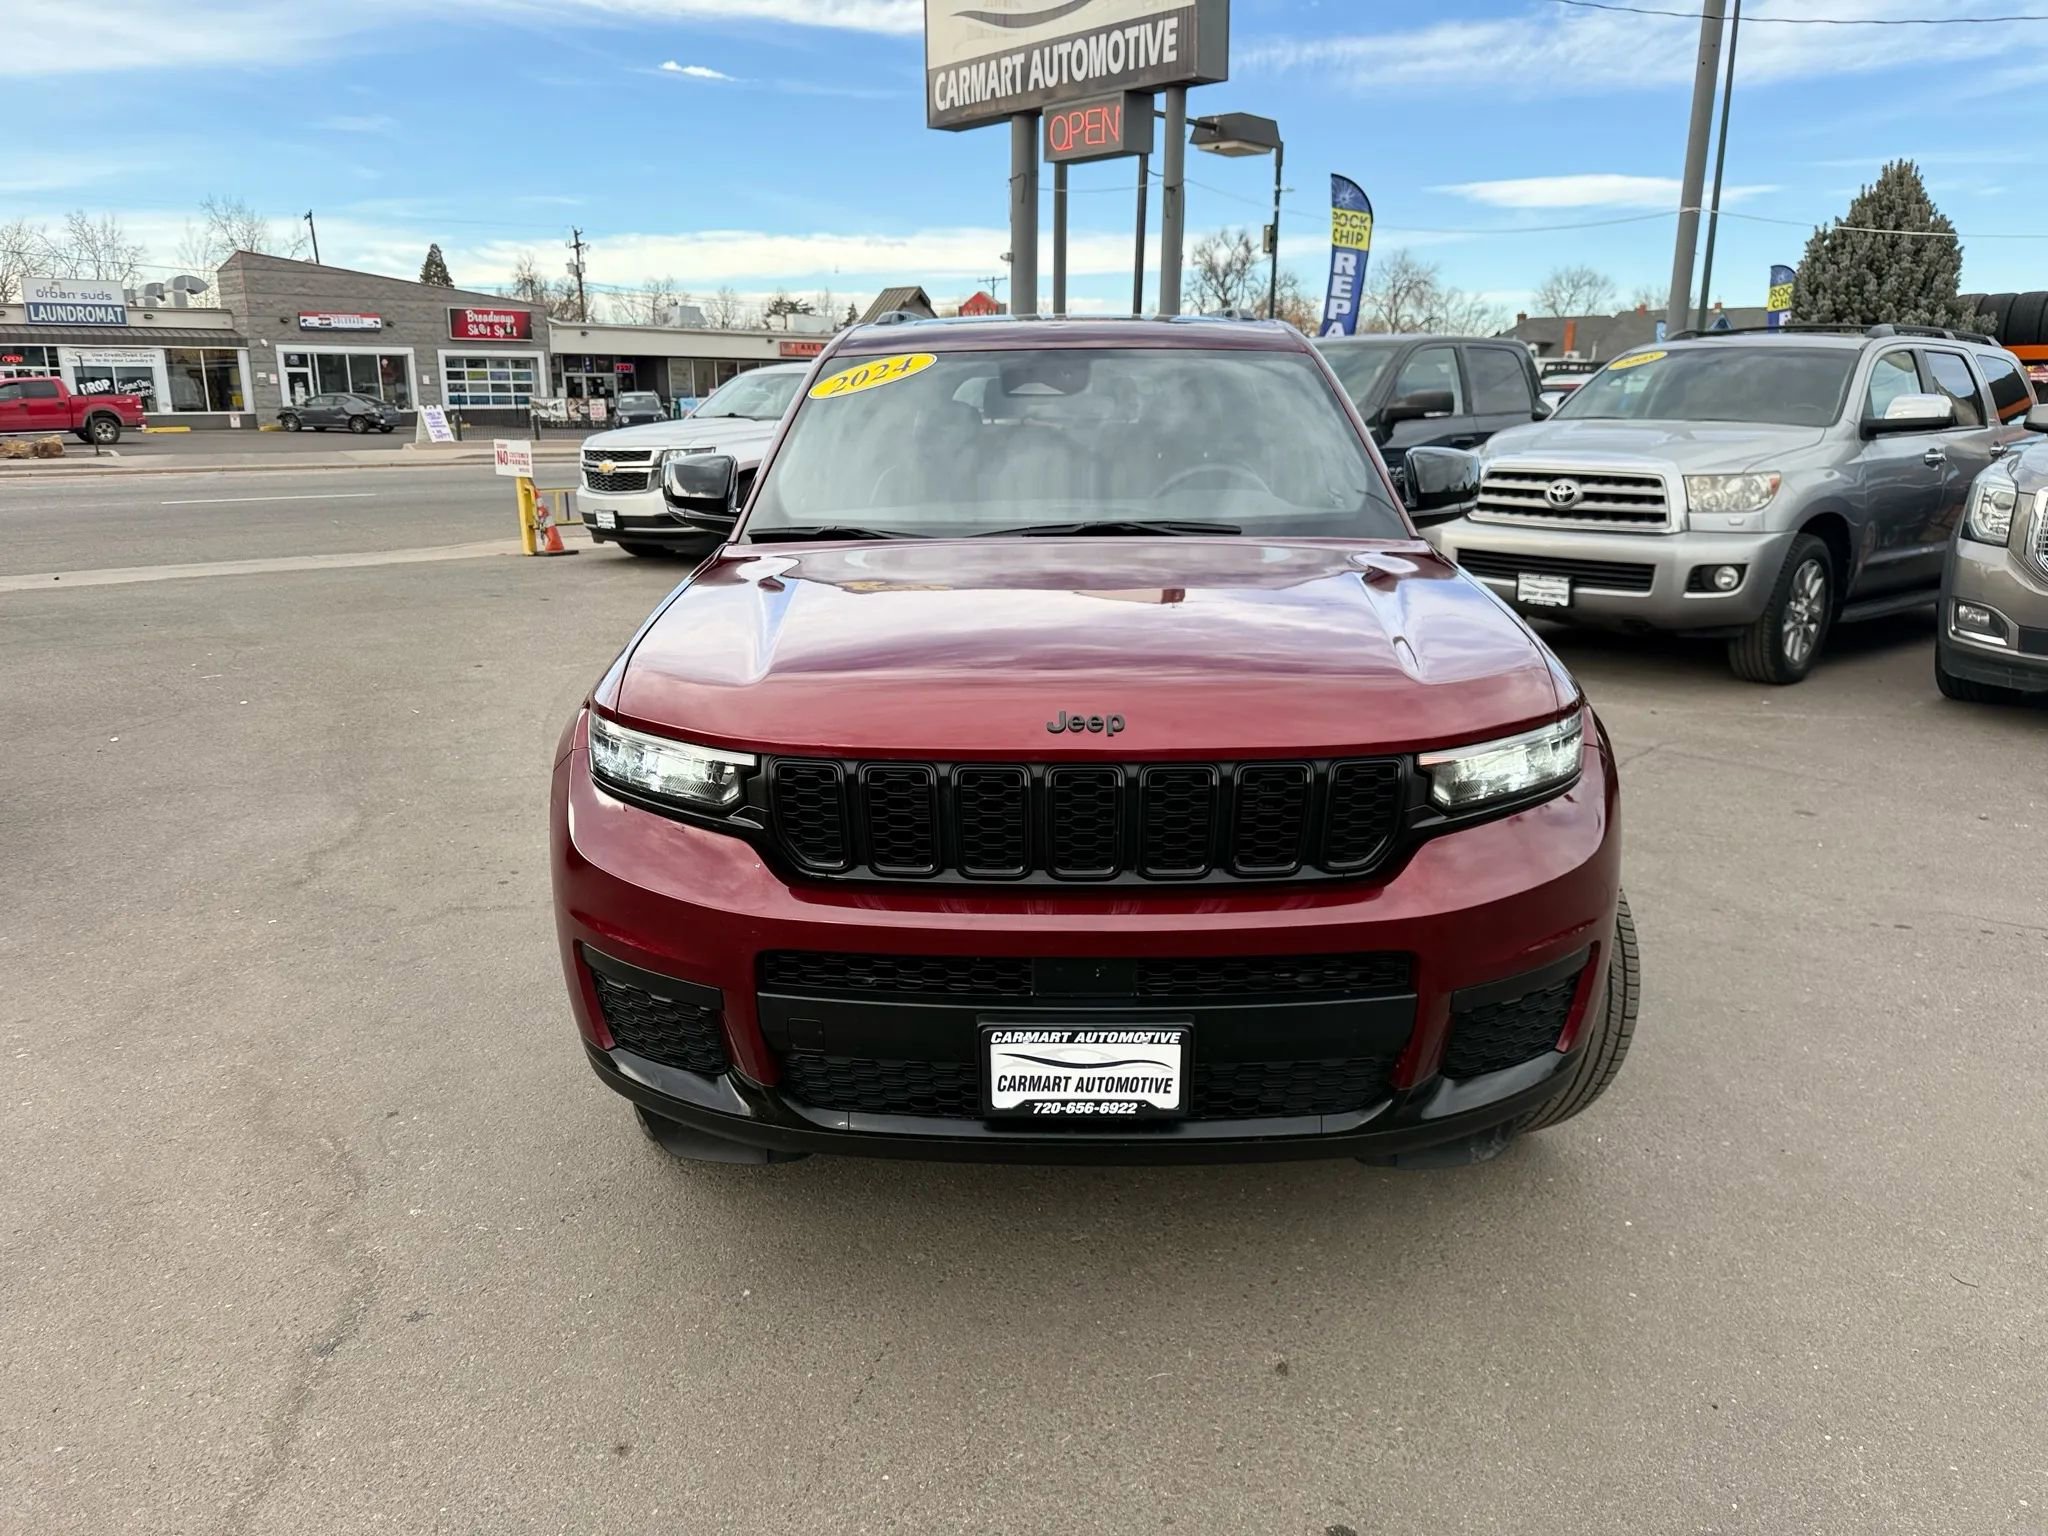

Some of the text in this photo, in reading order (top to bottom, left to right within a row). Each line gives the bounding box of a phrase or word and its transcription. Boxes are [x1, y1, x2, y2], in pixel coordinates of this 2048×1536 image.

[935, 16, 1178, 111] CARMART AUTOMOTIVE
[1050, 105, 1120, 151] OPEN
[36, 285, 112, 301] urban suds
[29, 304, 124, 323] LAUNDROMAT
[2, 354, 24, 363] OPEN
[830, 357, 914, 394] 2024
[496, 450, 508, 466] NO
[1047, 711, 1125, 737] Jeep
[990, 1031, 1181, 1044] CARMART AUTOMOTIVE
[997, 1075, 1174, 1095] CARMART AUTOMOTIVE
[1033, 1102, 1138, 1115] 720-656-6922
